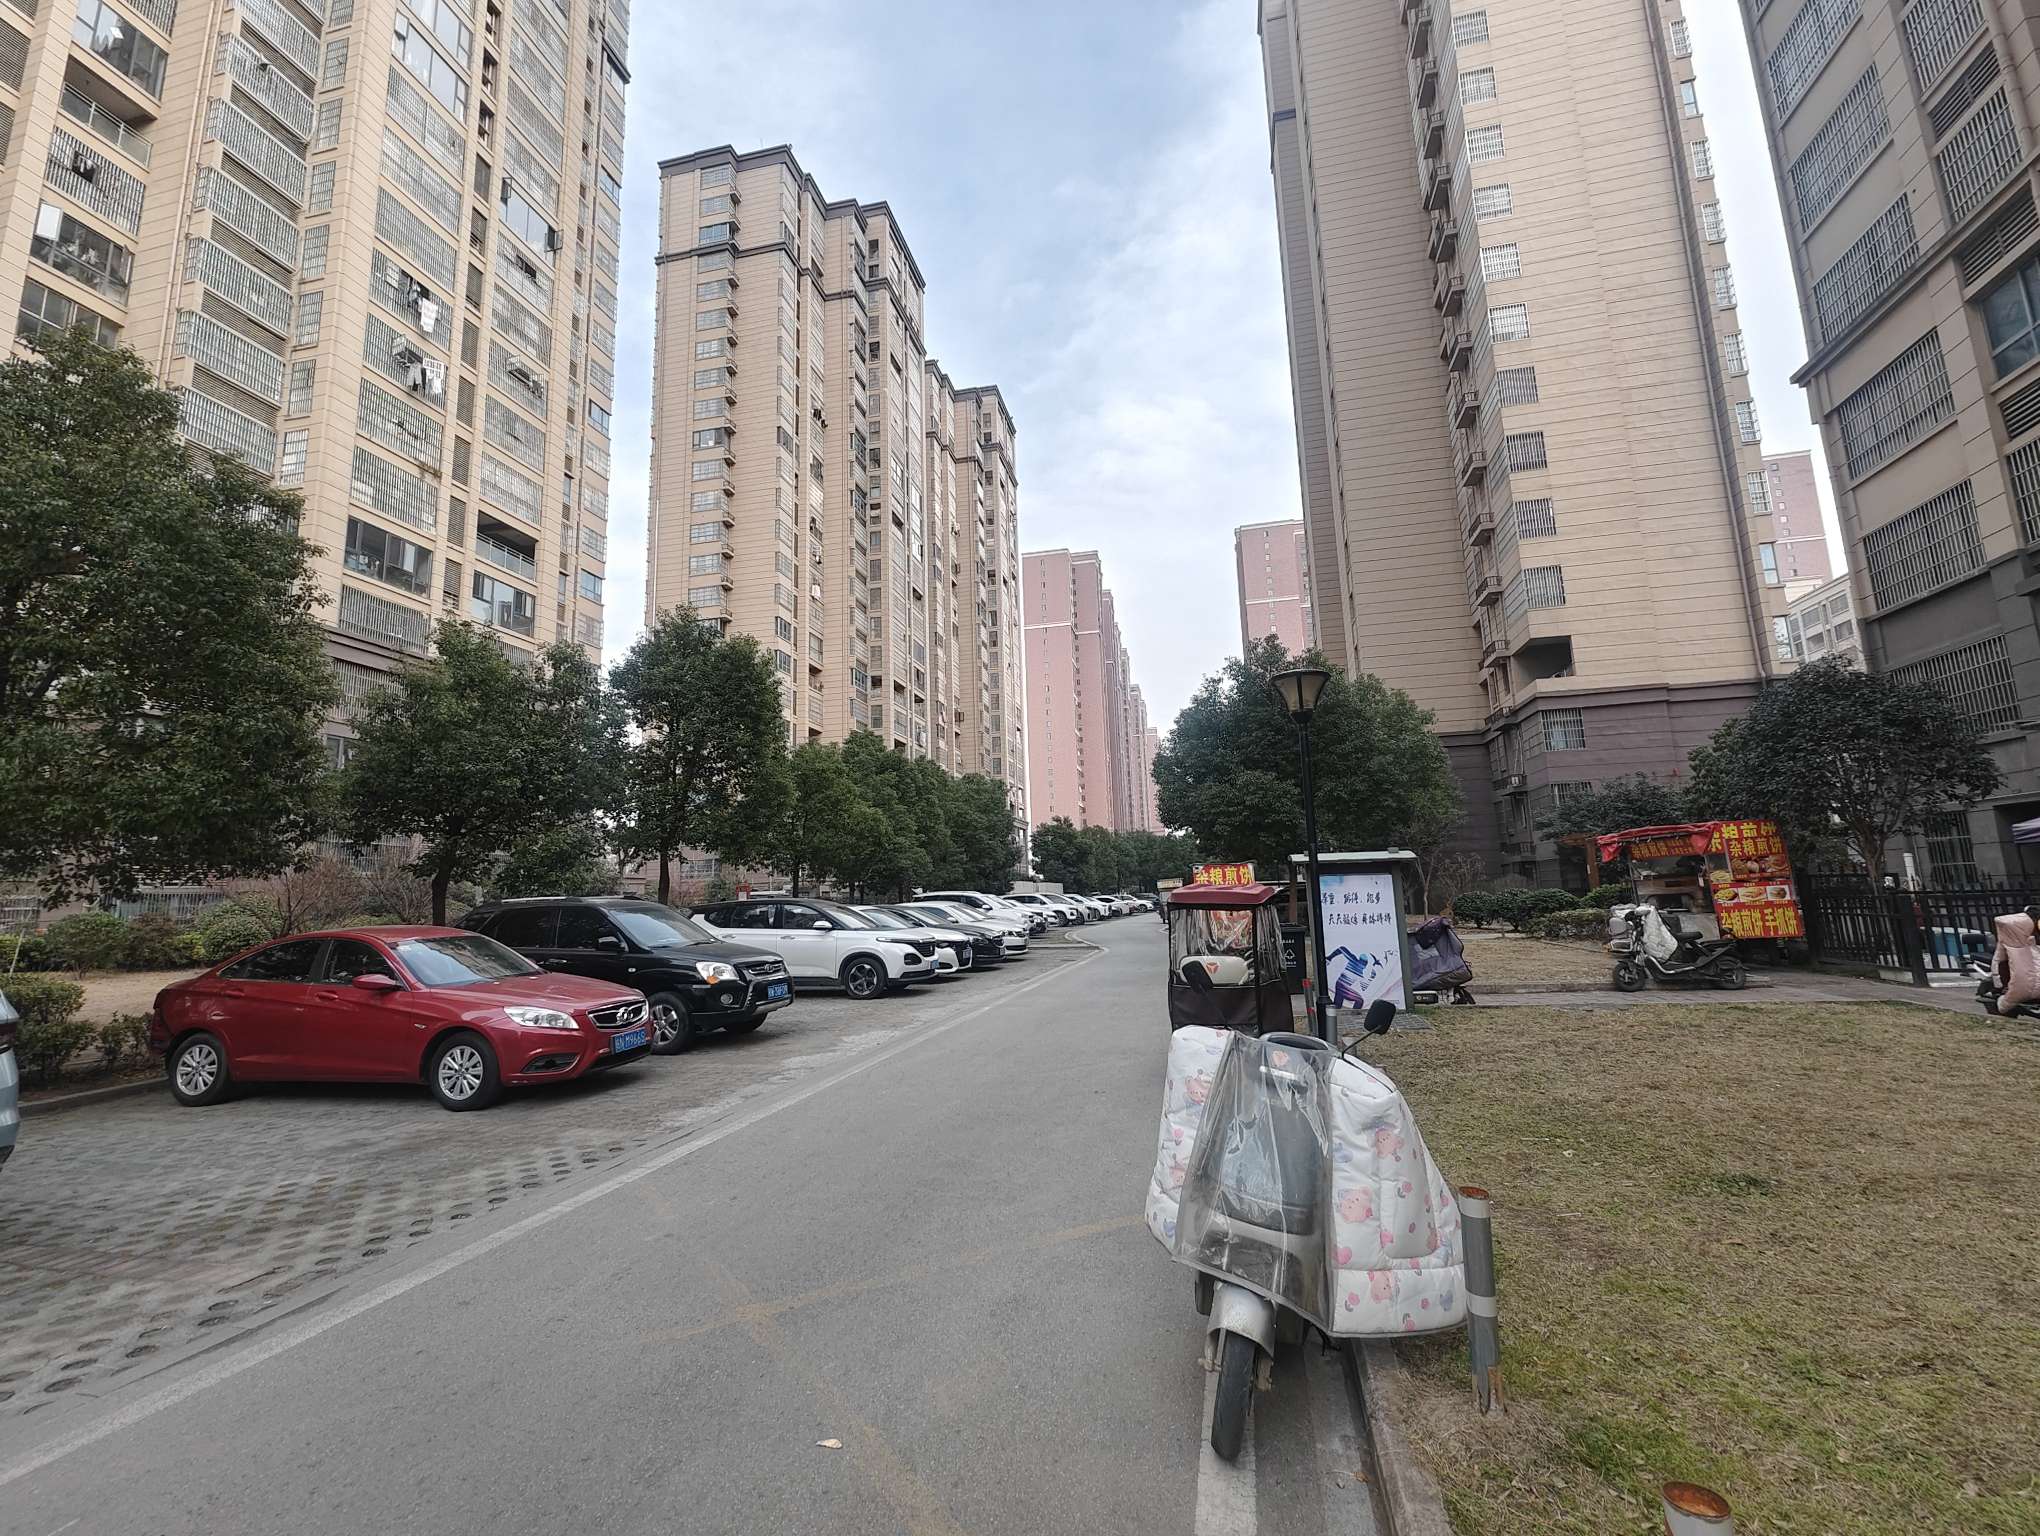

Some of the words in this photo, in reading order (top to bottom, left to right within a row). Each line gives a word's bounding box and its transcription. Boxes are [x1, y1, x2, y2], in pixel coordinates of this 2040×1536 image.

[1729, 836, 1782, 857] 杂粮煎饼
[1195, 866, 1252, 886] 杂粮煎饼
[1721, 909, 1763, 937] 杂粮煎饼
[1764, 906, 1798, 936] 手抓饼
